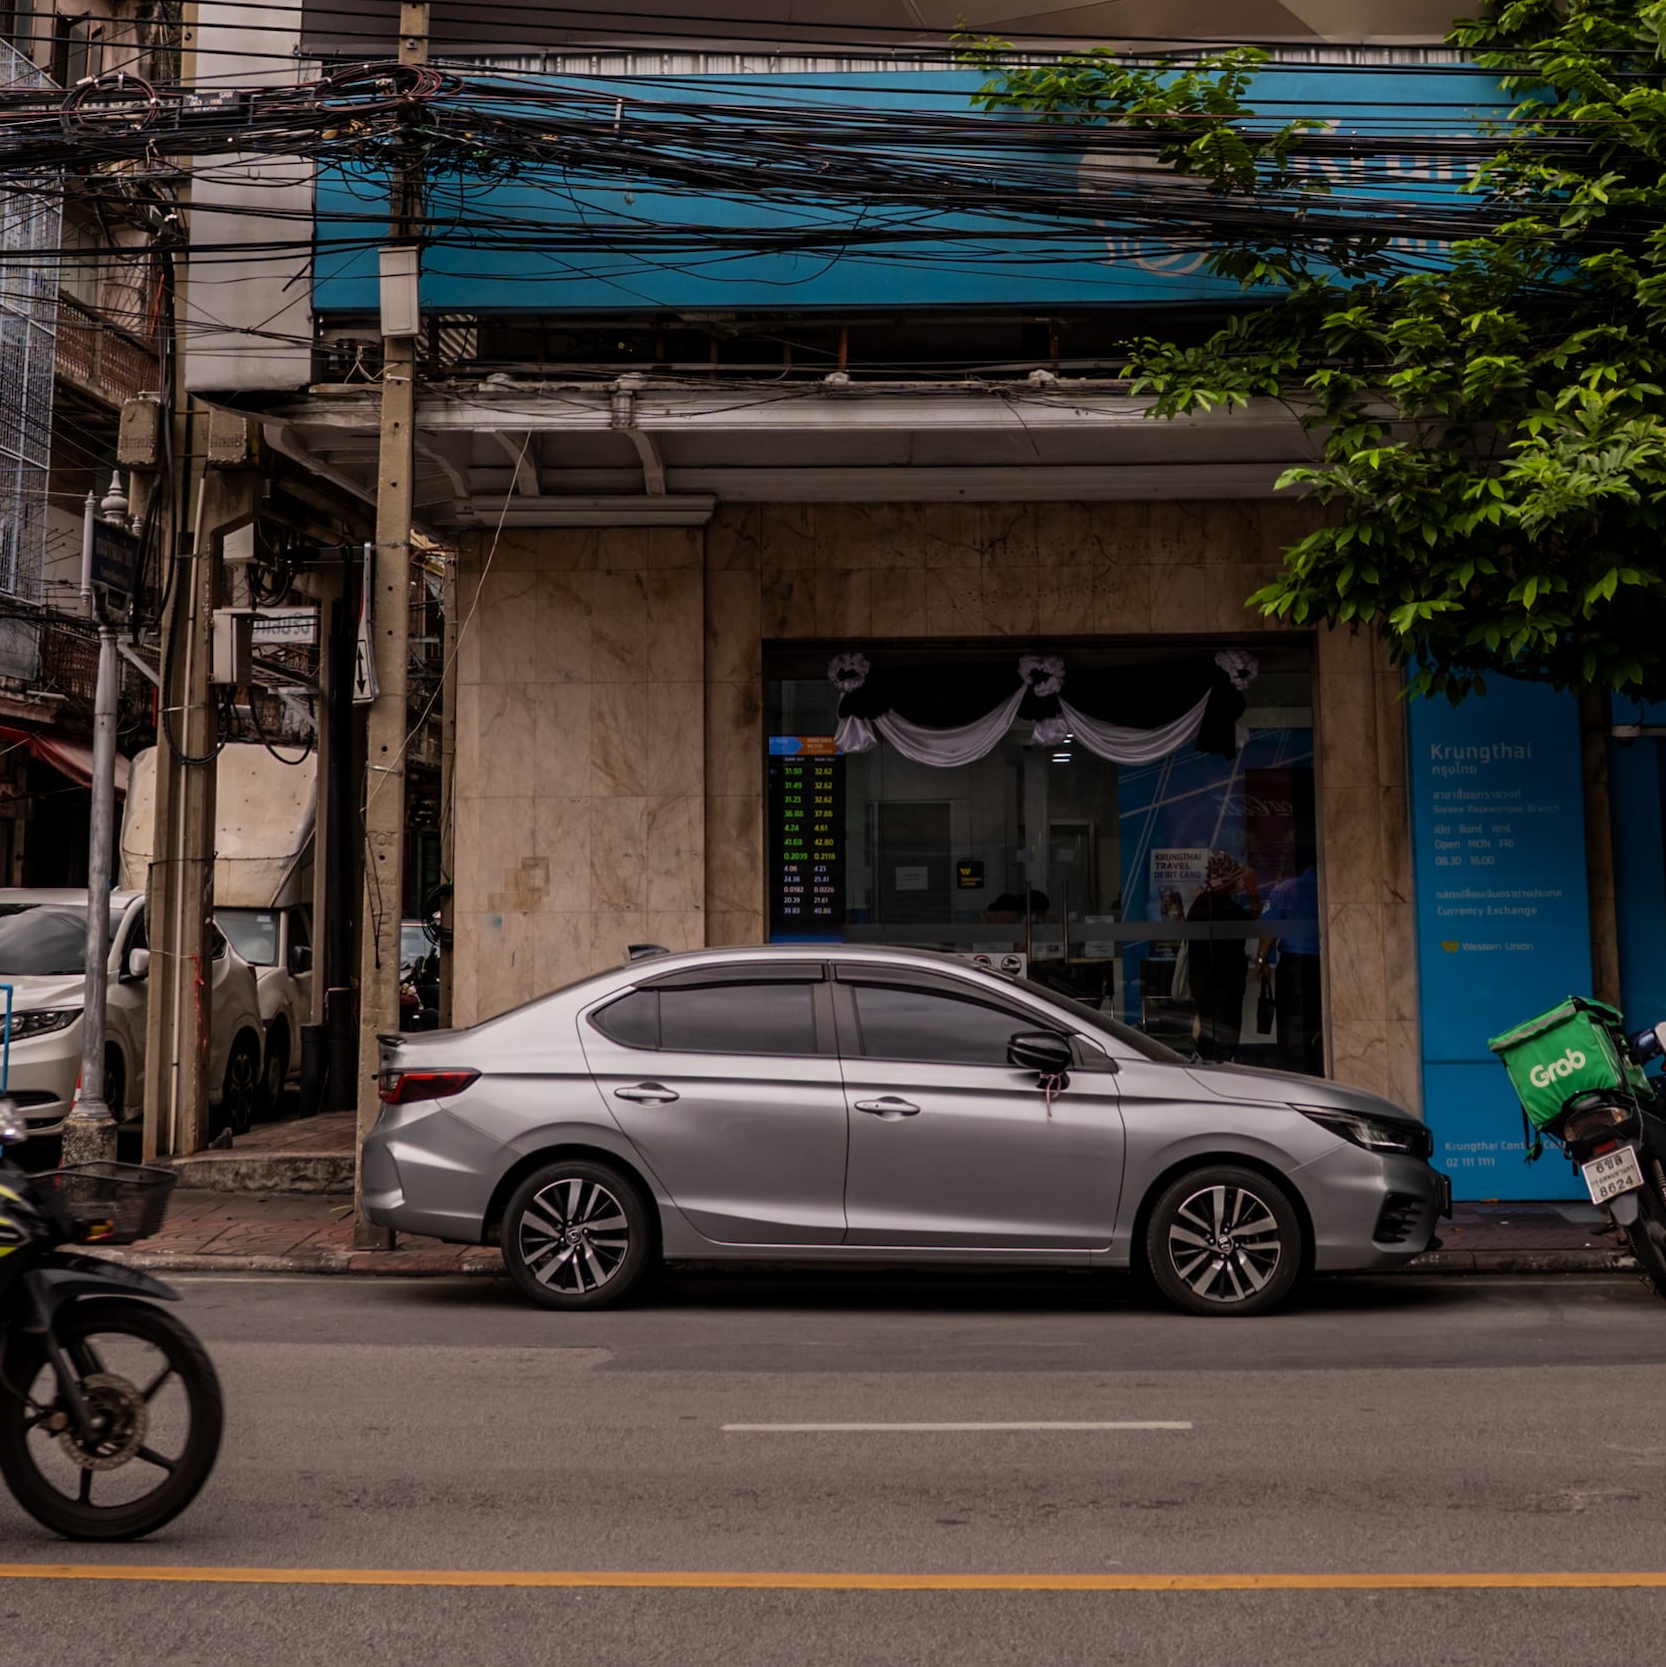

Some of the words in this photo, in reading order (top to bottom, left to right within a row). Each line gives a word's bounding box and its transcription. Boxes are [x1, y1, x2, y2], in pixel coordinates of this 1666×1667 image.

[1430, 741, 1532, 764] Krungthai
[1432, 761, 1478, 779] กรุงไทย
[1155, 853, 1202, 862] KRUNGTHAI
[1155, 862, 1190, 870] TRAVEL
[1437, 905, 1483, 917] Currency
[1487, 905, 1538, 917] Exchange
[1462, 942, 1502, 951] Western
[1505, 942, 1534, 951] Union
[1529, 1048, 1587, 1088] Grab
[1445, 1141, 1498, 1152] Krungthai
[1445, 1157, 1459, 1167] 02
[1599, 1175, 1634, 1198] 8624
